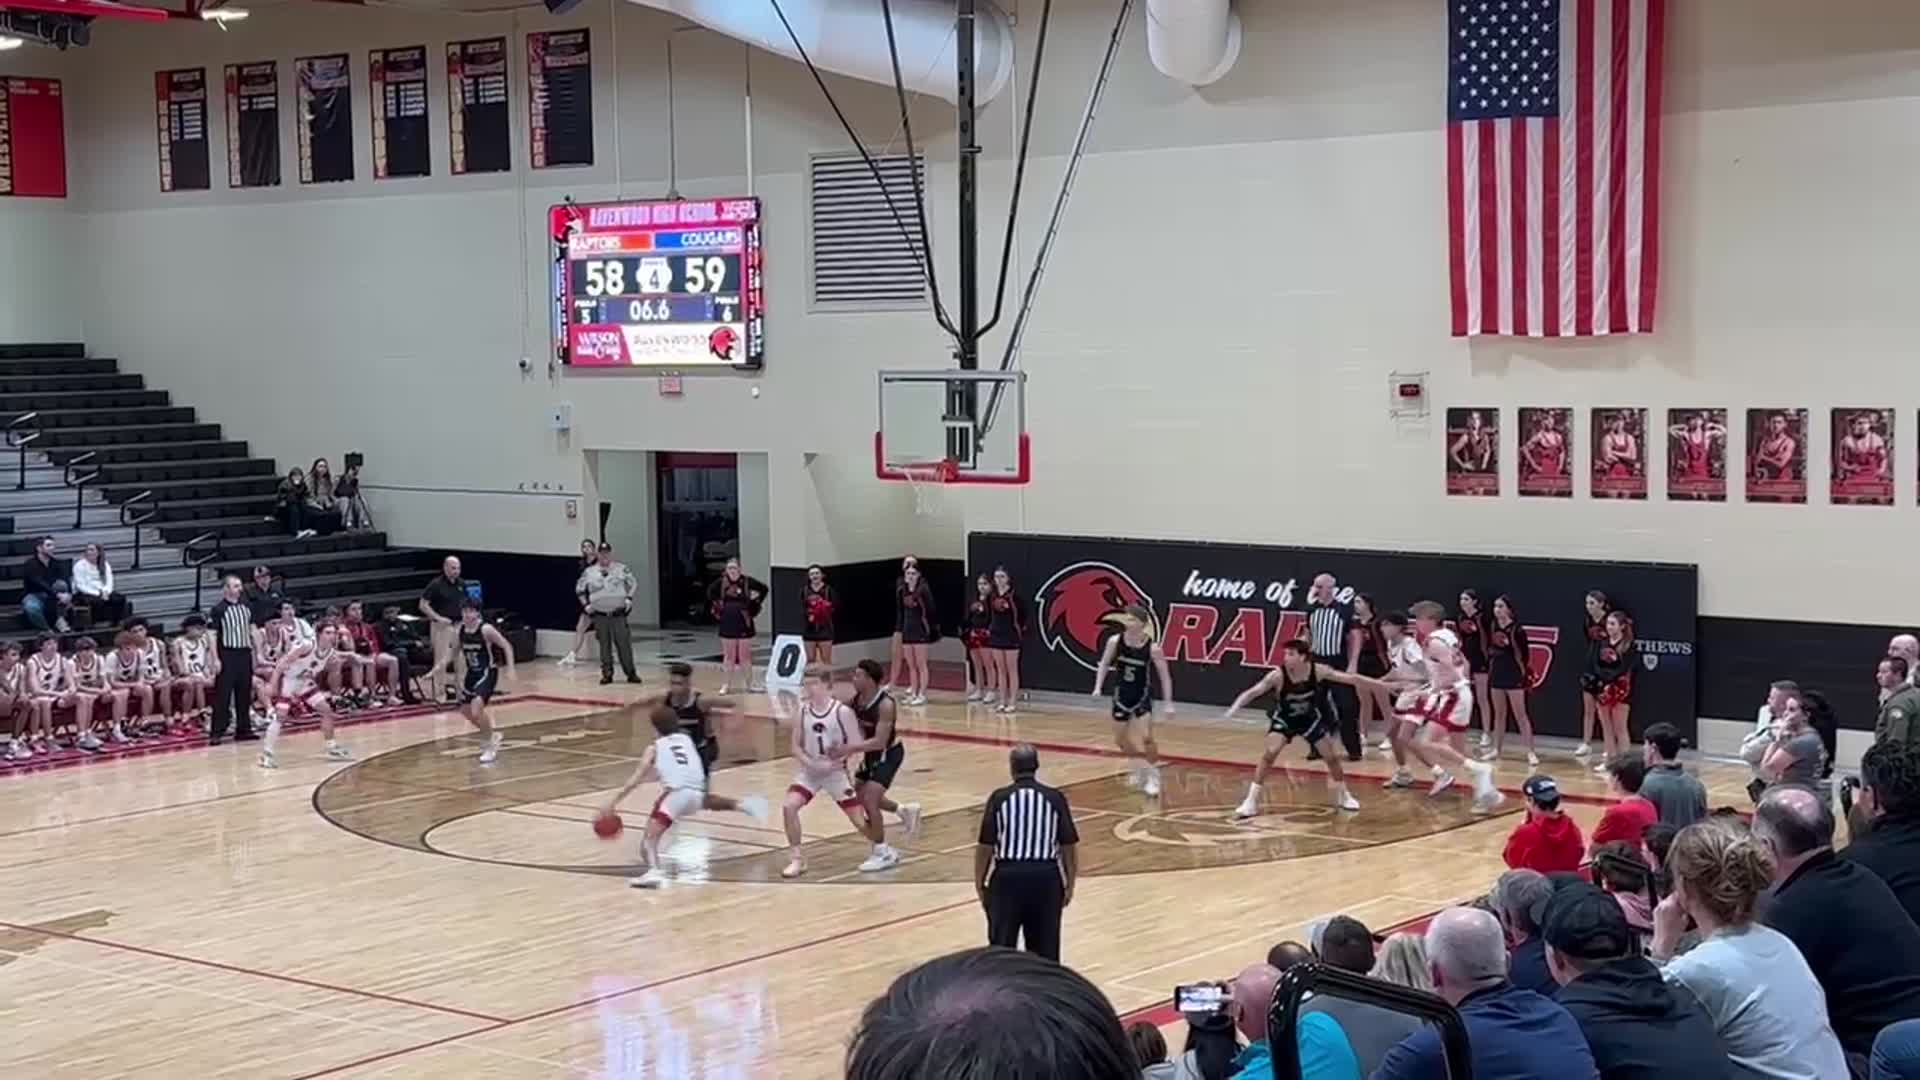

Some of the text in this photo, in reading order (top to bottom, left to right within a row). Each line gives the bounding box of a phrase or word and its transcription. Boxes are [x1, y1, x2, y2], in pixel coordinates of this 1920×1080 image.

[585, 260, 625, 296] 58
[648, 268, 661, 290] 4
[685, 256, 726, 294] 59
[581, 309, 591, 324] 5
[629, 299, 670, 321] 06.6
[722, 306, 733, 322] 6
[1183, 569, 1355, 607] home of te
[1634, 639, 1693, 656] THEWS
[776, 642, 801, 678] 0
[1123, 665, 1137, 682] 5
[817, 738, 826, 755] 1
